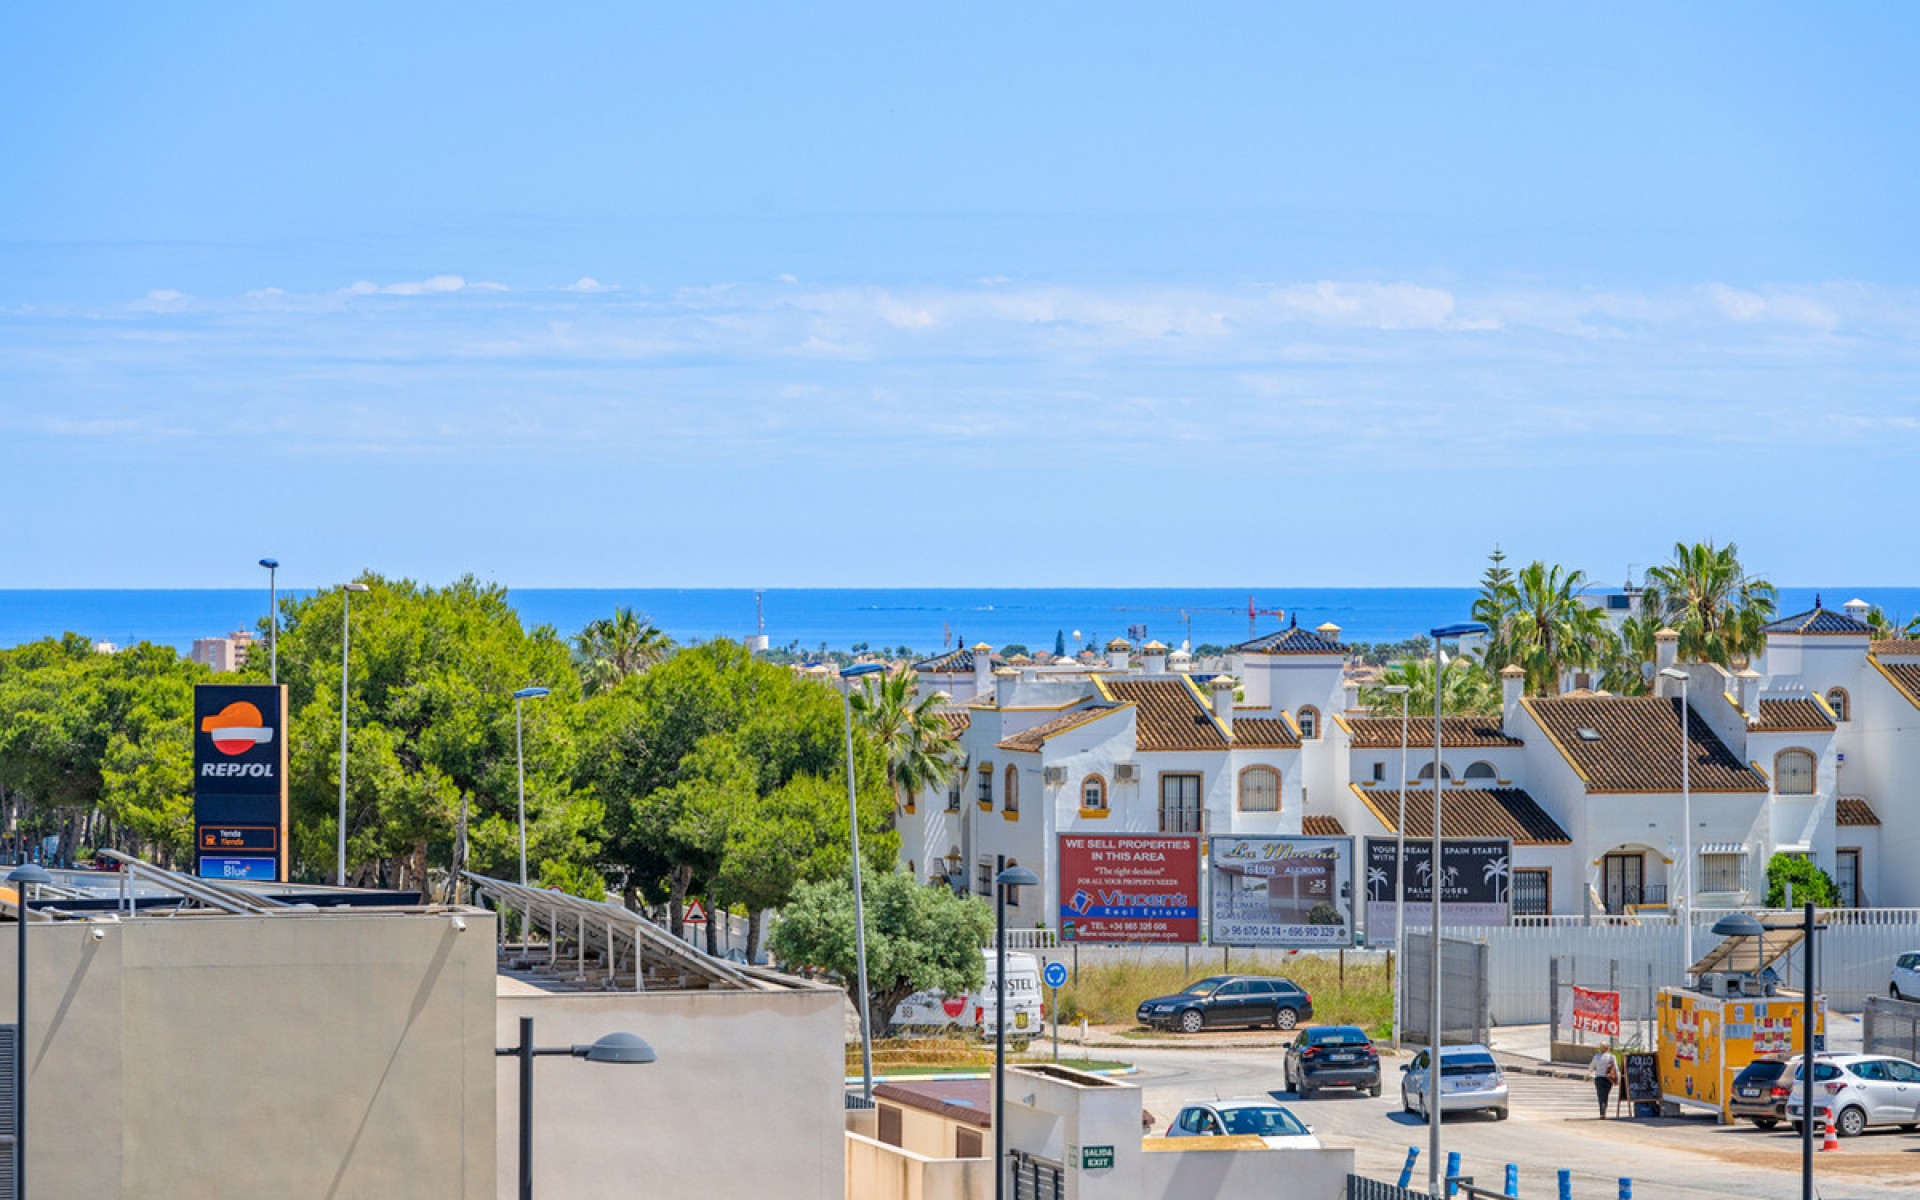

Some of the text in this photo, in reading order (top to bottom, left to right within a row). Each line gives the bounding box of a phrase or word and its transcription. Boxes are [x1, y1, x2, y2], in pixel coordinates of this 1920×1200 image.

[201, 763, 274, 777] REPSOL
[220, 838, 244, 846] Tienda
[1066, 840, 1190, 849] WE SELL PROPERTIES
[1222, 842, 1256, 859] La
[1372, 846, 1396, 854] YOUR
[1472, 847, 1503, 855] STARTS
[1091, 852, 1165, 861] IN THIS AREA
[1372, 854, 1395, 862] WITH
[1098, 889, 1188, 907] Vincent
[1105, 908, 1187, 916] Real Estate
[1231, 925, 1241, 935] 96
[990, 979, 1033, 990] ASTEL
[1084, 1148, 1113, 1157] SALIDA
[1088, 1158, 1108, 1167] EXIT
